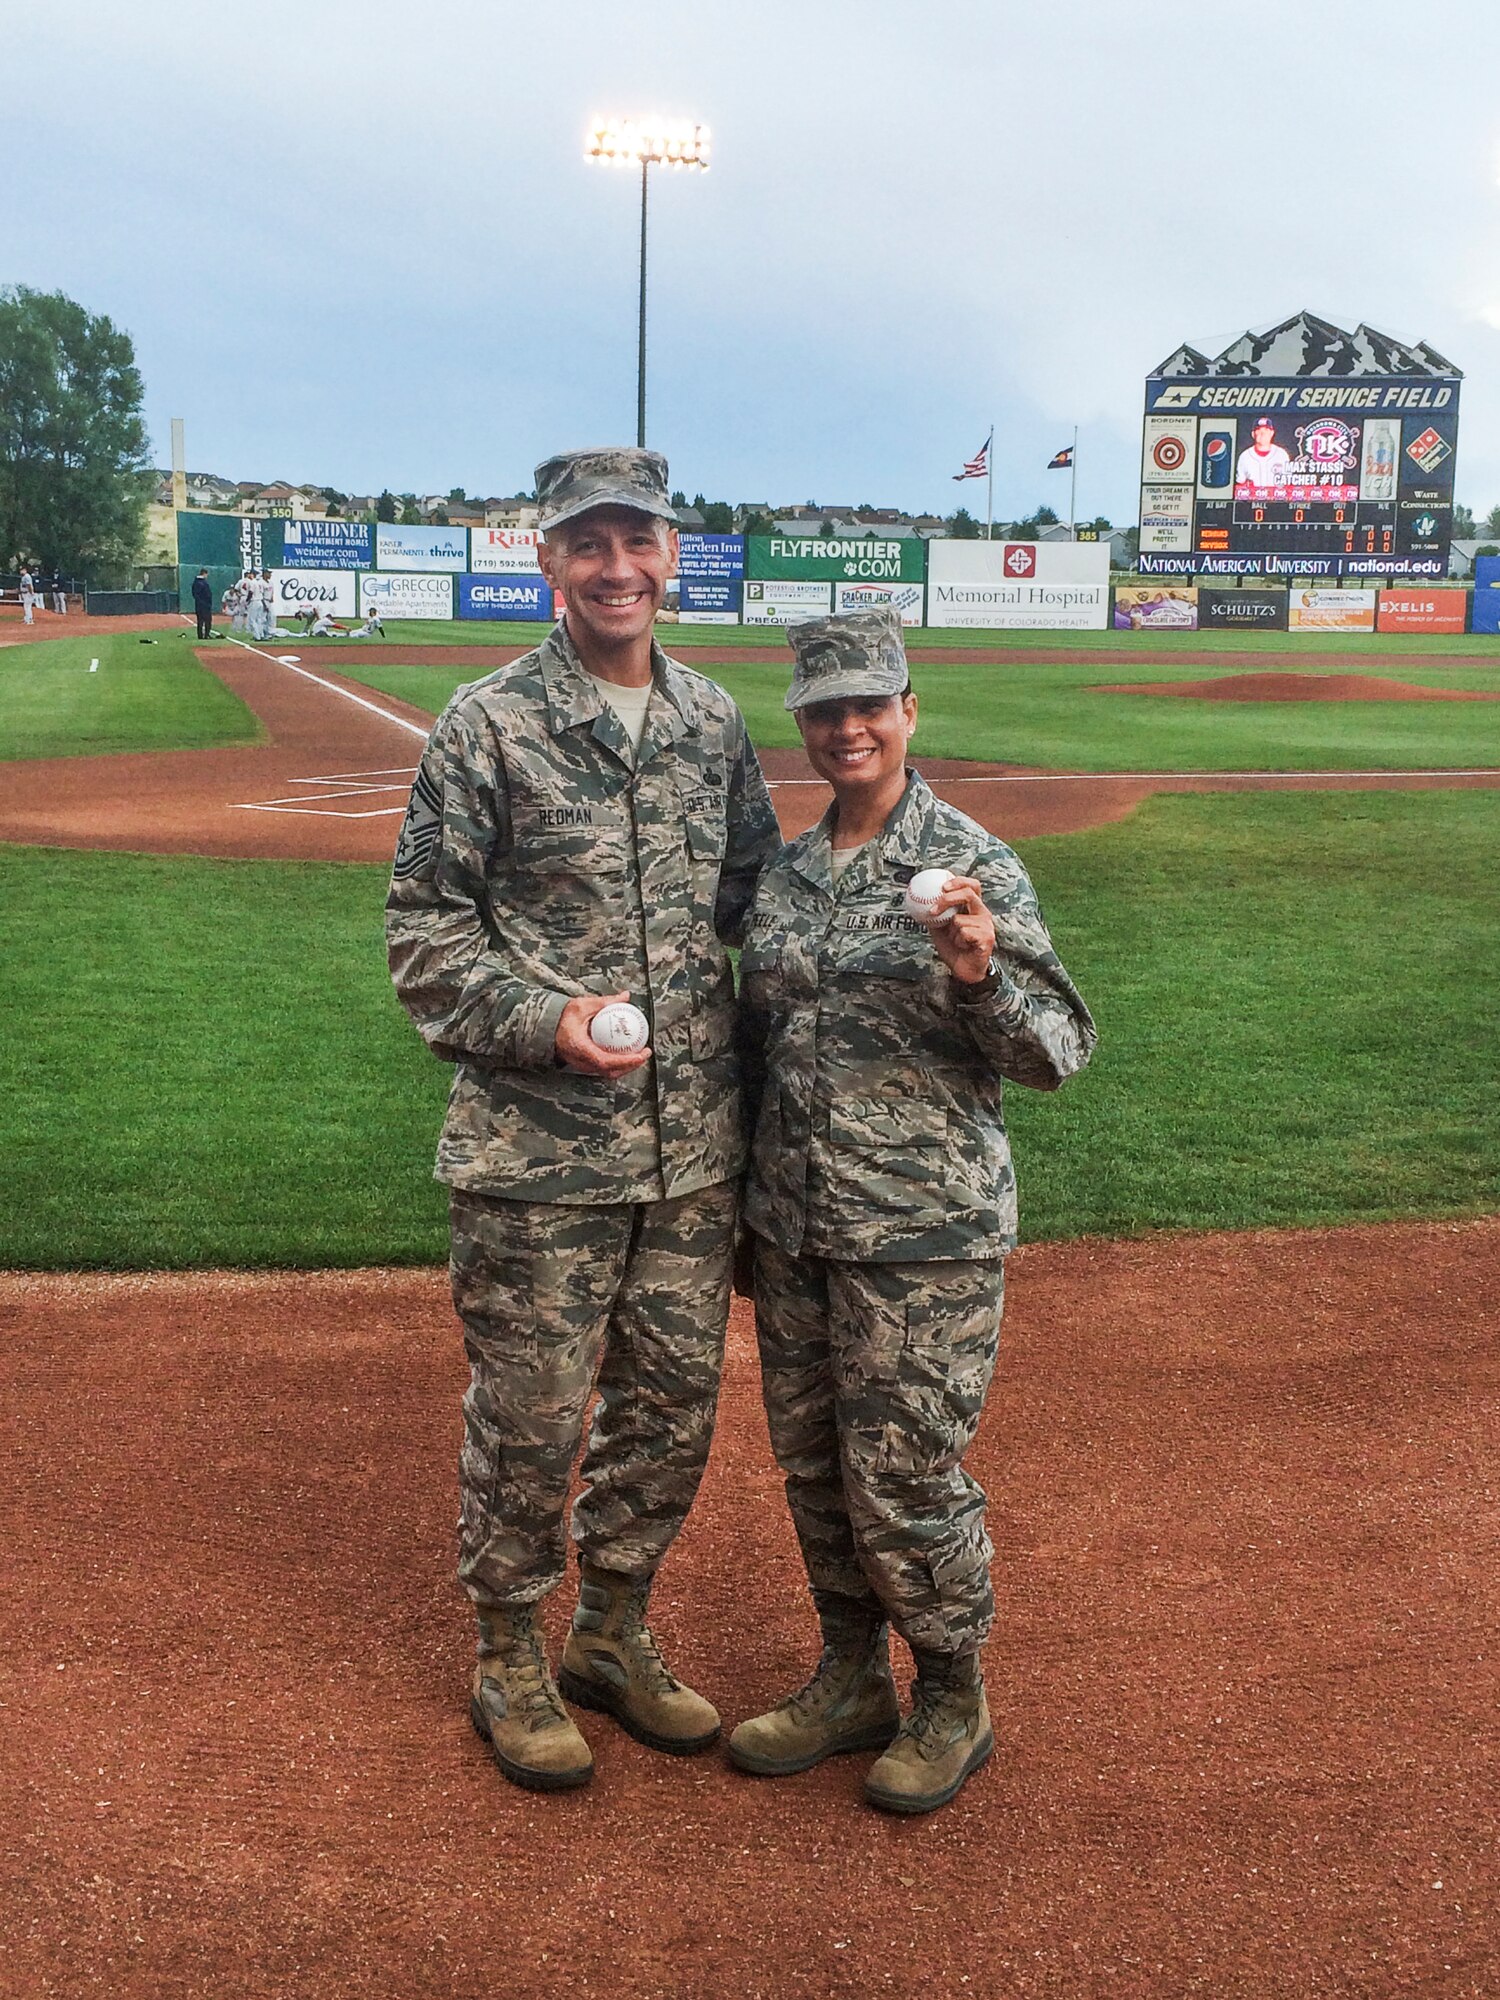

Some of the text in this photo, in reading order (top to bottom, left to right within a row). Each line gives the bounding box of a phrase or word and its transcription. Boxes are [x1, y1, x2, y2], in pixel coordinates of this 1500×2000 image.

[1198, 387, 1452, 408] SECURITY SERVICE FIELD
[1285, 461, 1344, 473] MAX STASSI
[1274, 475, 1344, 486] CATCHER #10
[1288, 502, 1311, 510] STRIKE
[272, 508, 292, 518] 350
[1255, 509, 1264, 522] 0
[1295, 509, 1304, 522] 0
[1335, 509, 1344, 523] 0
[302, 521, 369, 539] WEIDNER
[1079, 532, 1097, 541] 385
[1346, 531, 1390, 541] 0 0 0
[305, 537, 369, 547] APARTMENT HOMES
[721, 542, 741, 553] Inn
[1345, 542, 1390, 552] 0 0 0
[294, 545, 359, 558] weidner.com
[430, 545, 464, 557] thrive
[770, 539, 901, 559] FLYFRONTIER
[283, 555, 299, 567] Live
[321, 557, 339, 568] with
[474, 559, 497, 568] (719)
[1139, 554, 1442, 574] NATIONAL AMERICAN UNIVERSITY national.edu
[280, 578, 339, 601] Coors
[391, 578, 451, 592] GRECCIO
[470, 585, 539, 603] GILDAN
[841, 590, 893, 603] CRACKER JACK
[936, 586, 1100, 609] Memorial Hospital
[405, 600, 448, 609] Apartments
[1380, 601, 1435, 614] EXELIS
[945, 617, 1089, 627] UNIVERSITY OF COLORADO HEALTH
[540, 809, 593, 825] REDMAN
[846, 914, 869, 929] U.S.
[872, 916, 893, 931] AIR
